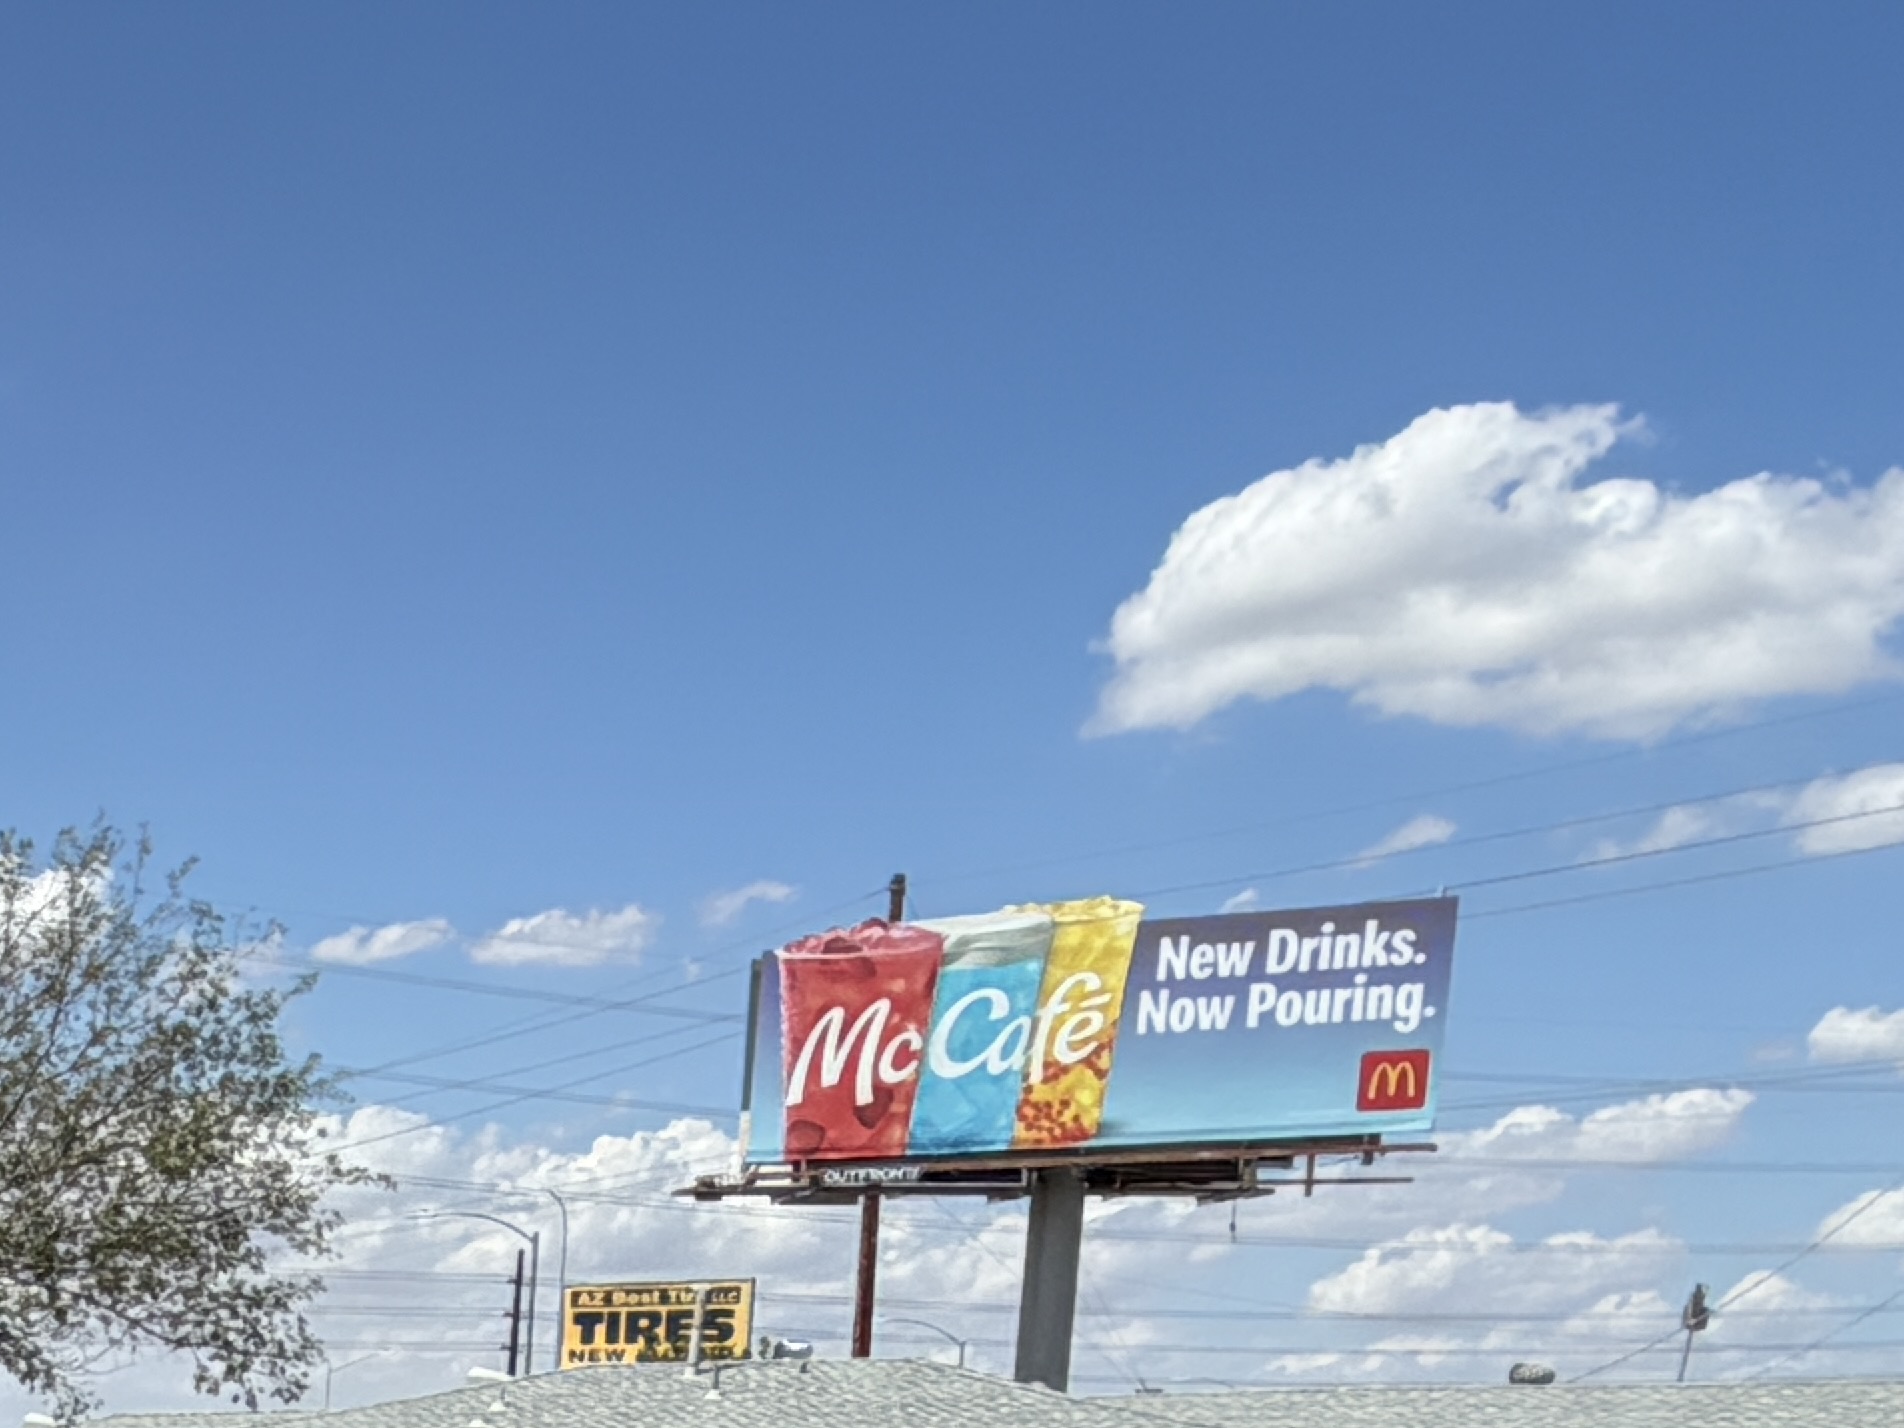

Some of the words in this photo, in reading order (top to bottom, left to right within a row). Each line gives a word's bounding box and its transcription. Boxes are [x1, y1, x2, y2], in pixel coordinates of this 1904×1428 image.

[1156, 934, 1256, 982] New
[1265, 918, 1427, 974] Drinks.
[1136, 989, 1236, 1034] Now
[1246, 973, 1436, 1034] Pouring.
[785, 972, 1111, 1106] McCafé
[573, 1309, 736, 1344] TIRES
